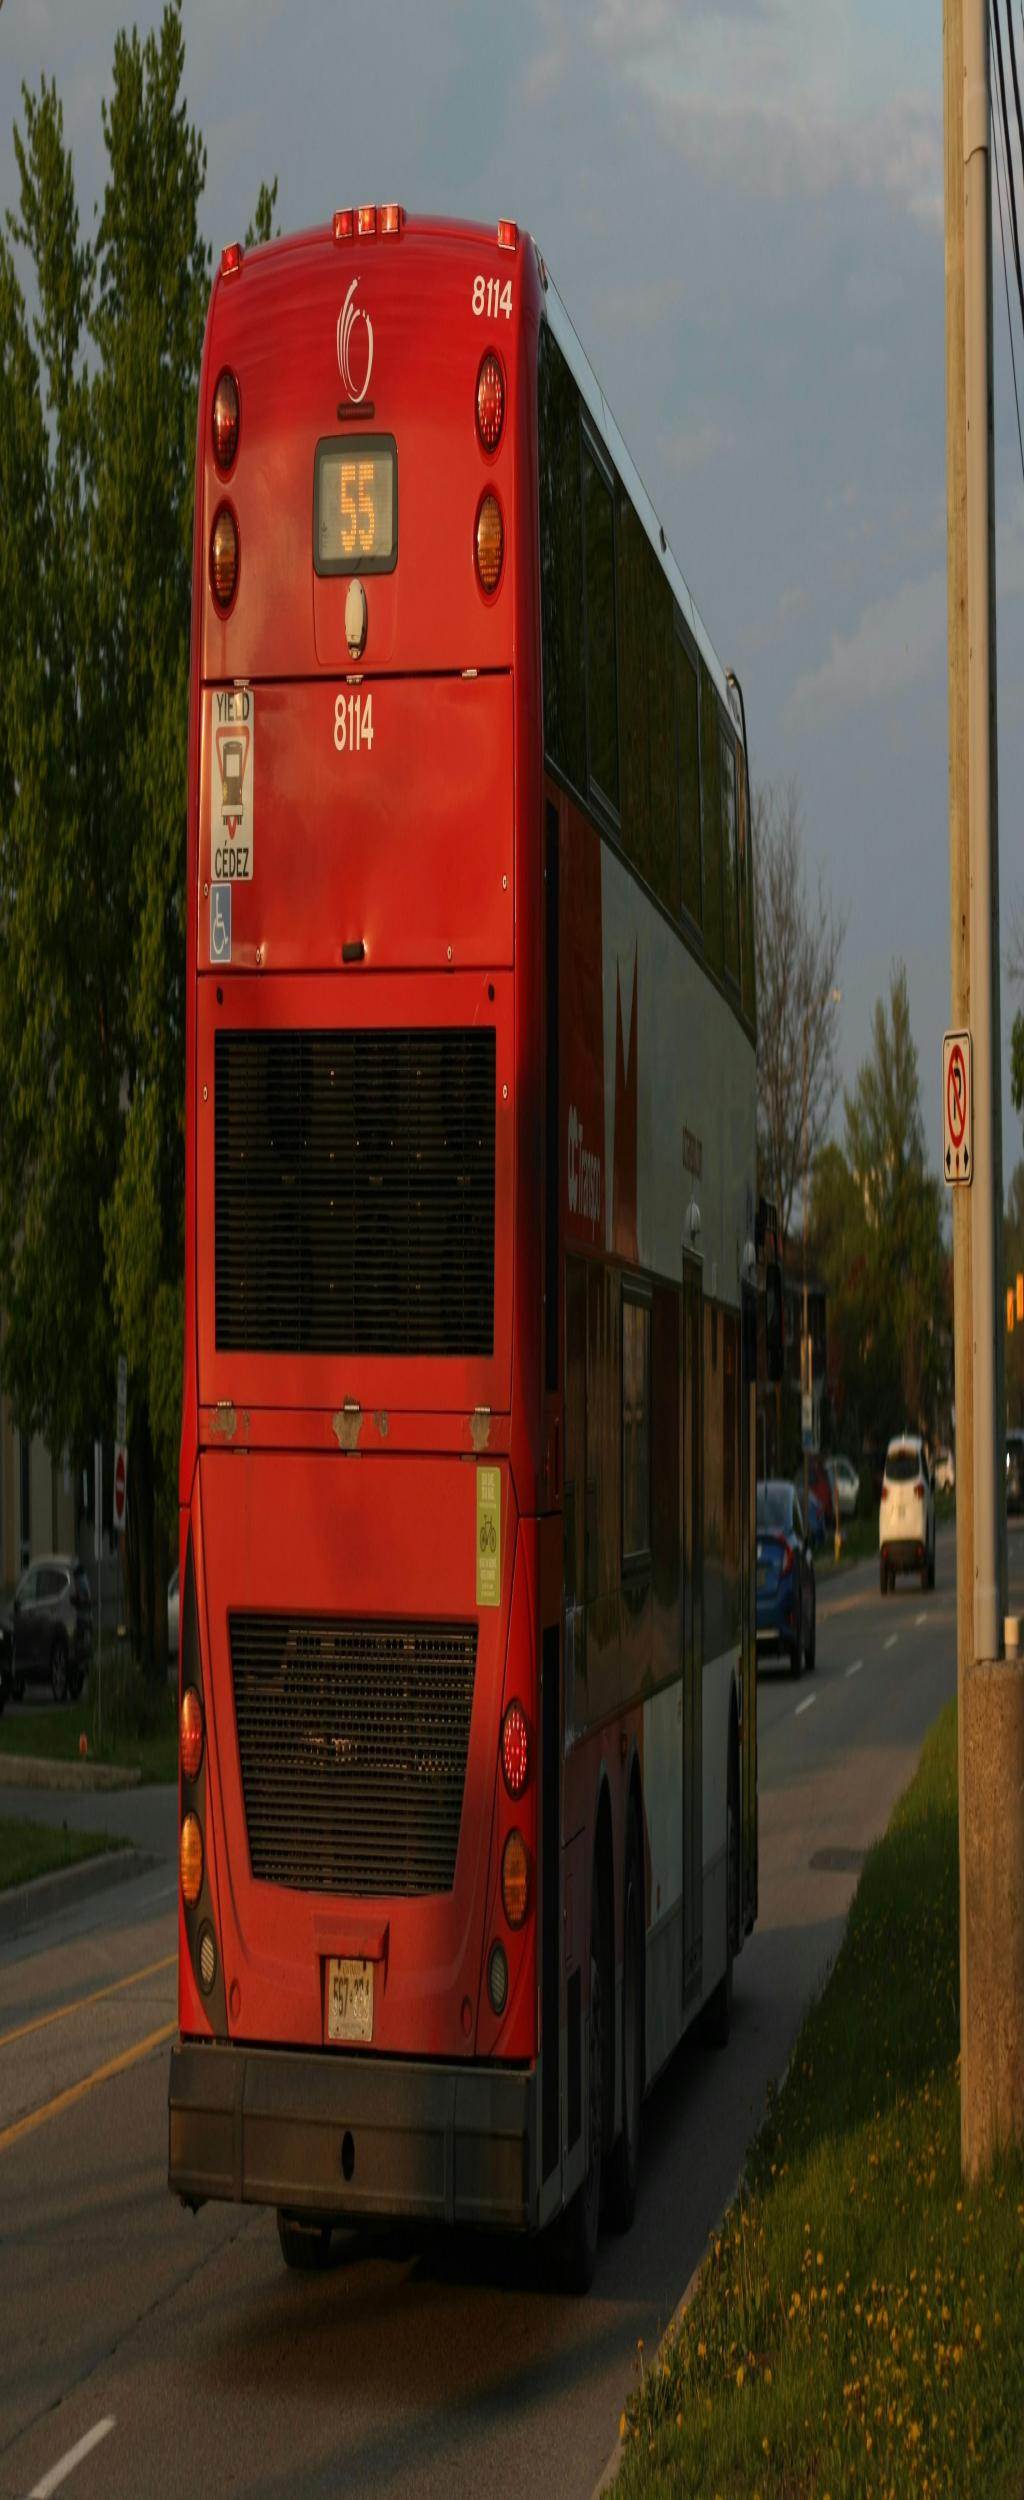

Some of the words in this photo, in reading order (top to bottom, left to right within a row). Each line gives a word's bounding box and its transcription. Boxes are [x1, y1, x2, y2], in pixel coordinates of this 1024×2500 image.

[471, 275, 513, 320] 8114
[340, 463, 376, 552] 55
[216, 692, 250, 722] YIELD
[333, 693, 374, 751] 8114
[215, 842, 250, 878] CÉDEZ
